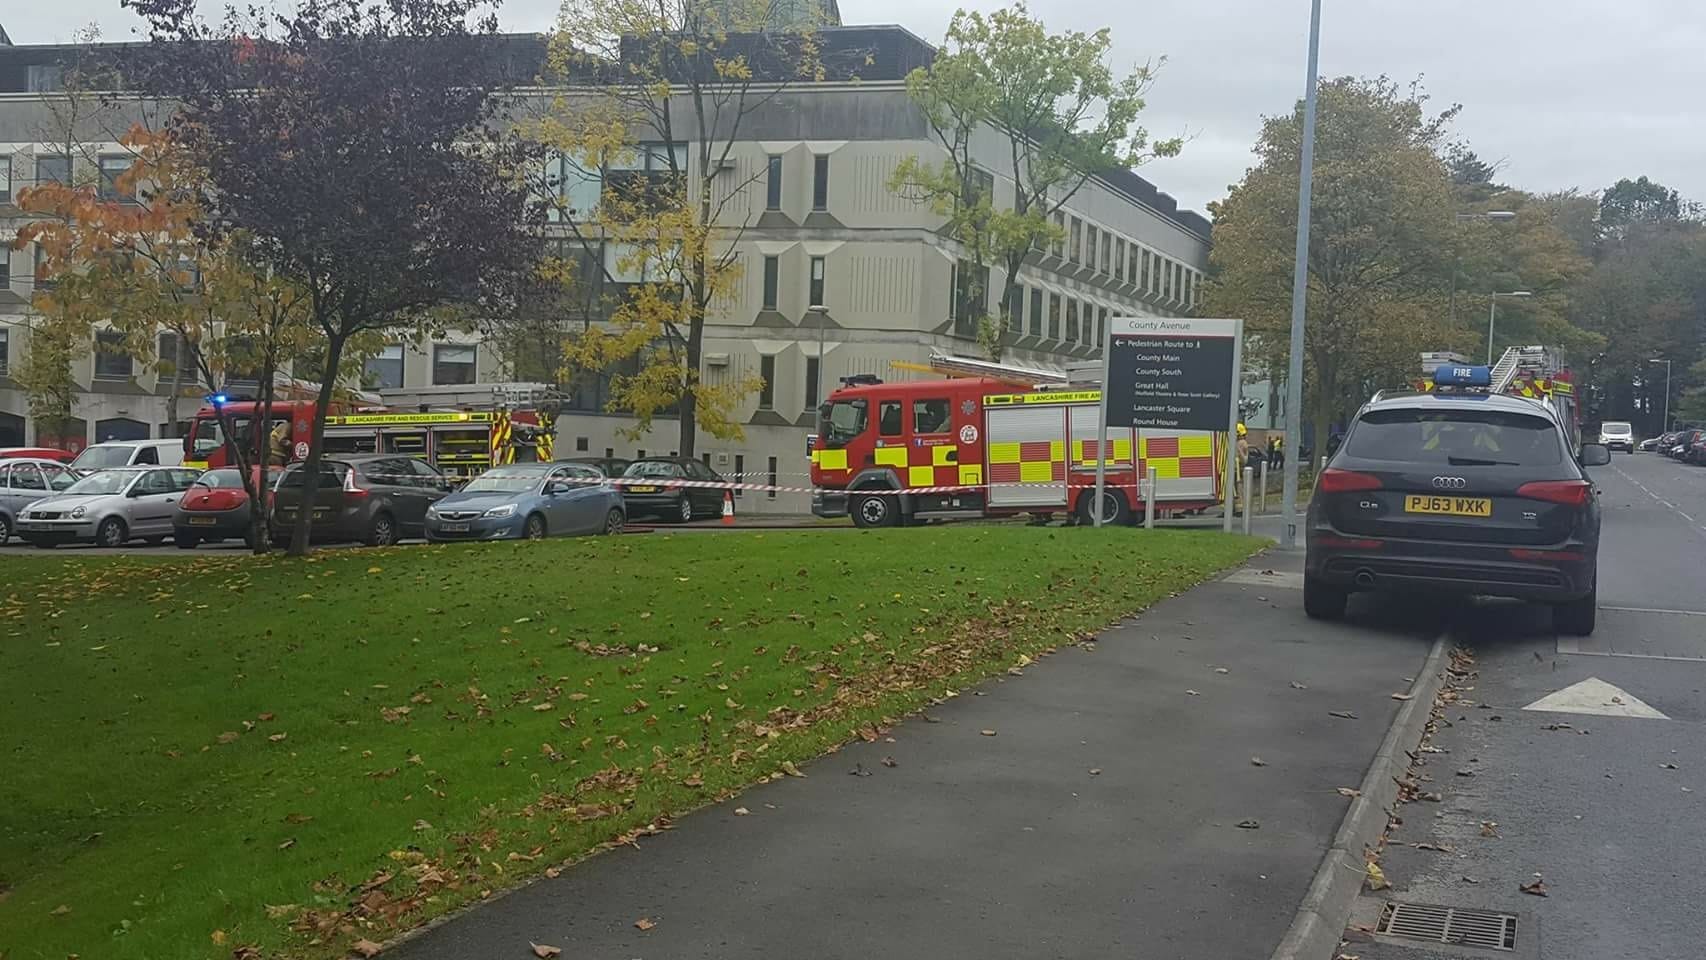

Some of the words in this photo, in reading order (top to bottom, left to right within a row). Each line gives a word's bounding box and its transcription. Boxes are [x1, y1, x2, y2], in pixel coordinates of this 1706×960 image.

[1129, 321, 1158, 330] County
[1160, 321, 1191, 330] Avenue
[1128, 340, 1163, 348] Pedestrian
[1164, 340, 1184, 348] Route
[1136, 354, 1161, 362] County
[1136, 368, 1160, 377] County
[1161, 368, 1182, 376] South
[1453, 367, 1472, 377] FIRE
[1135, 382, 1154, 390] Great
[1155, 382, 1169, 390] Hall
[1032, 393, 1073, 401] LANCASHIRE
[1074, 392, 1090, 400] FIRE
[1090, 391, 1101, 399] AN
[1133, 404, 1166, 412] Lancaster
[1167, 405, 1191, 413] Square
[352, 415, 384, 423] LANCASHIRE
[431, 413, 454, 421] SERVICE
[1411, 497, 1451, 511] PJ63
[1455, 499, 1486, 513] WXK
